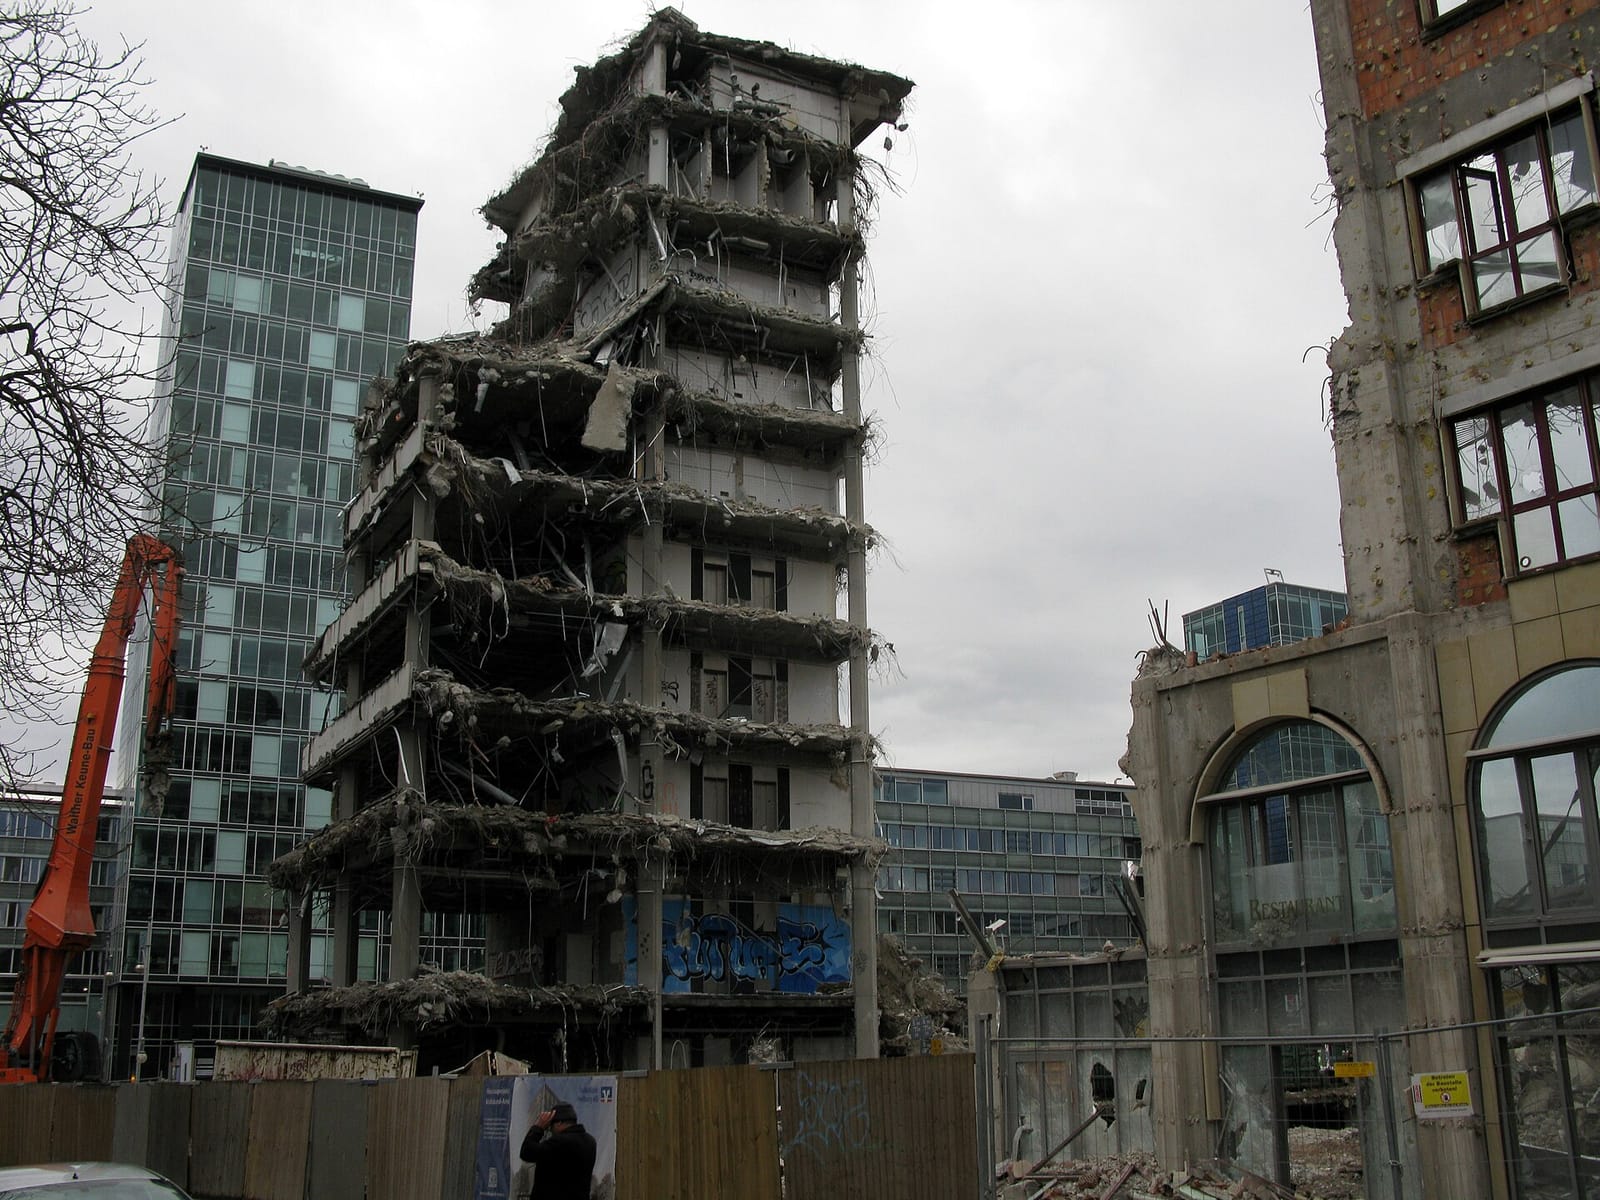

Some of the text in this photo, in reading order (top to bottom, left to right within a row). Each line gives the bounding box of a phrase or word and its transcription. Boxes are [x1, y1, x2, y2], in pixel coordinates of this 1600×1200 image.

[67, 729, 96, 835] Walther Keune-Bau
[1249, 895, 1345, 921] RESTAURANT
